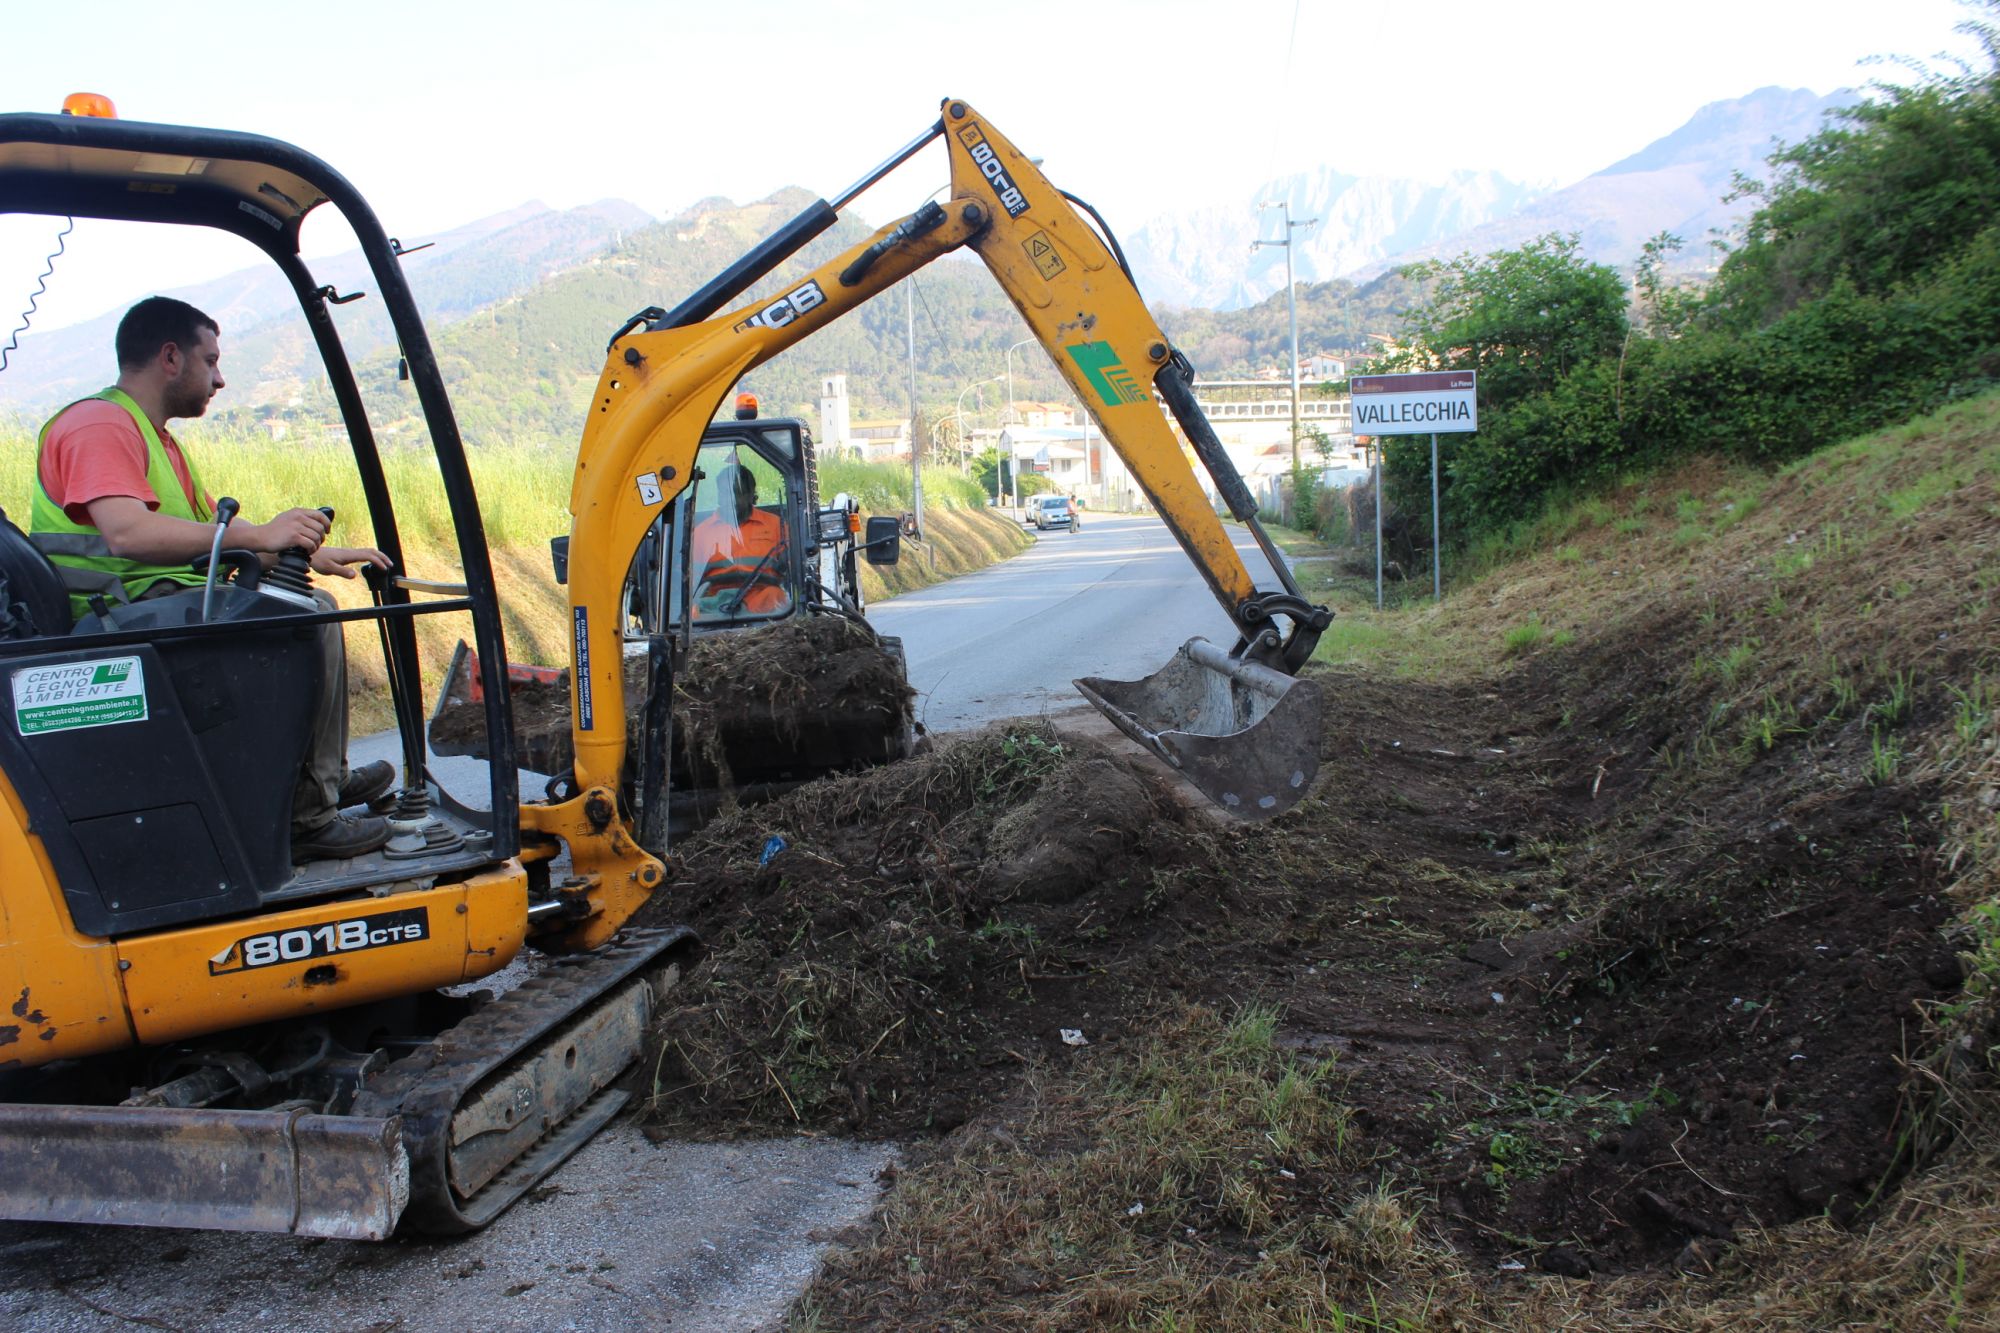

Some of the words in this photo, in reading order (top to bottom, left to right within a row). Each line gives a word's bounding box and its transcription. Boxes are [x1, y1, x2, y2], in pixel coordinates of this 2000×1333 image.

[1357, 401, 1470, 423] VALLECCHIA
[28, 666, 95, 683] CENTRO
[22, 682, 126, 705] AMBIENTE
[26, 678, 89, 694] LEGNO
[25, 698, 138, 719] www.centrolegnoambiente.it
